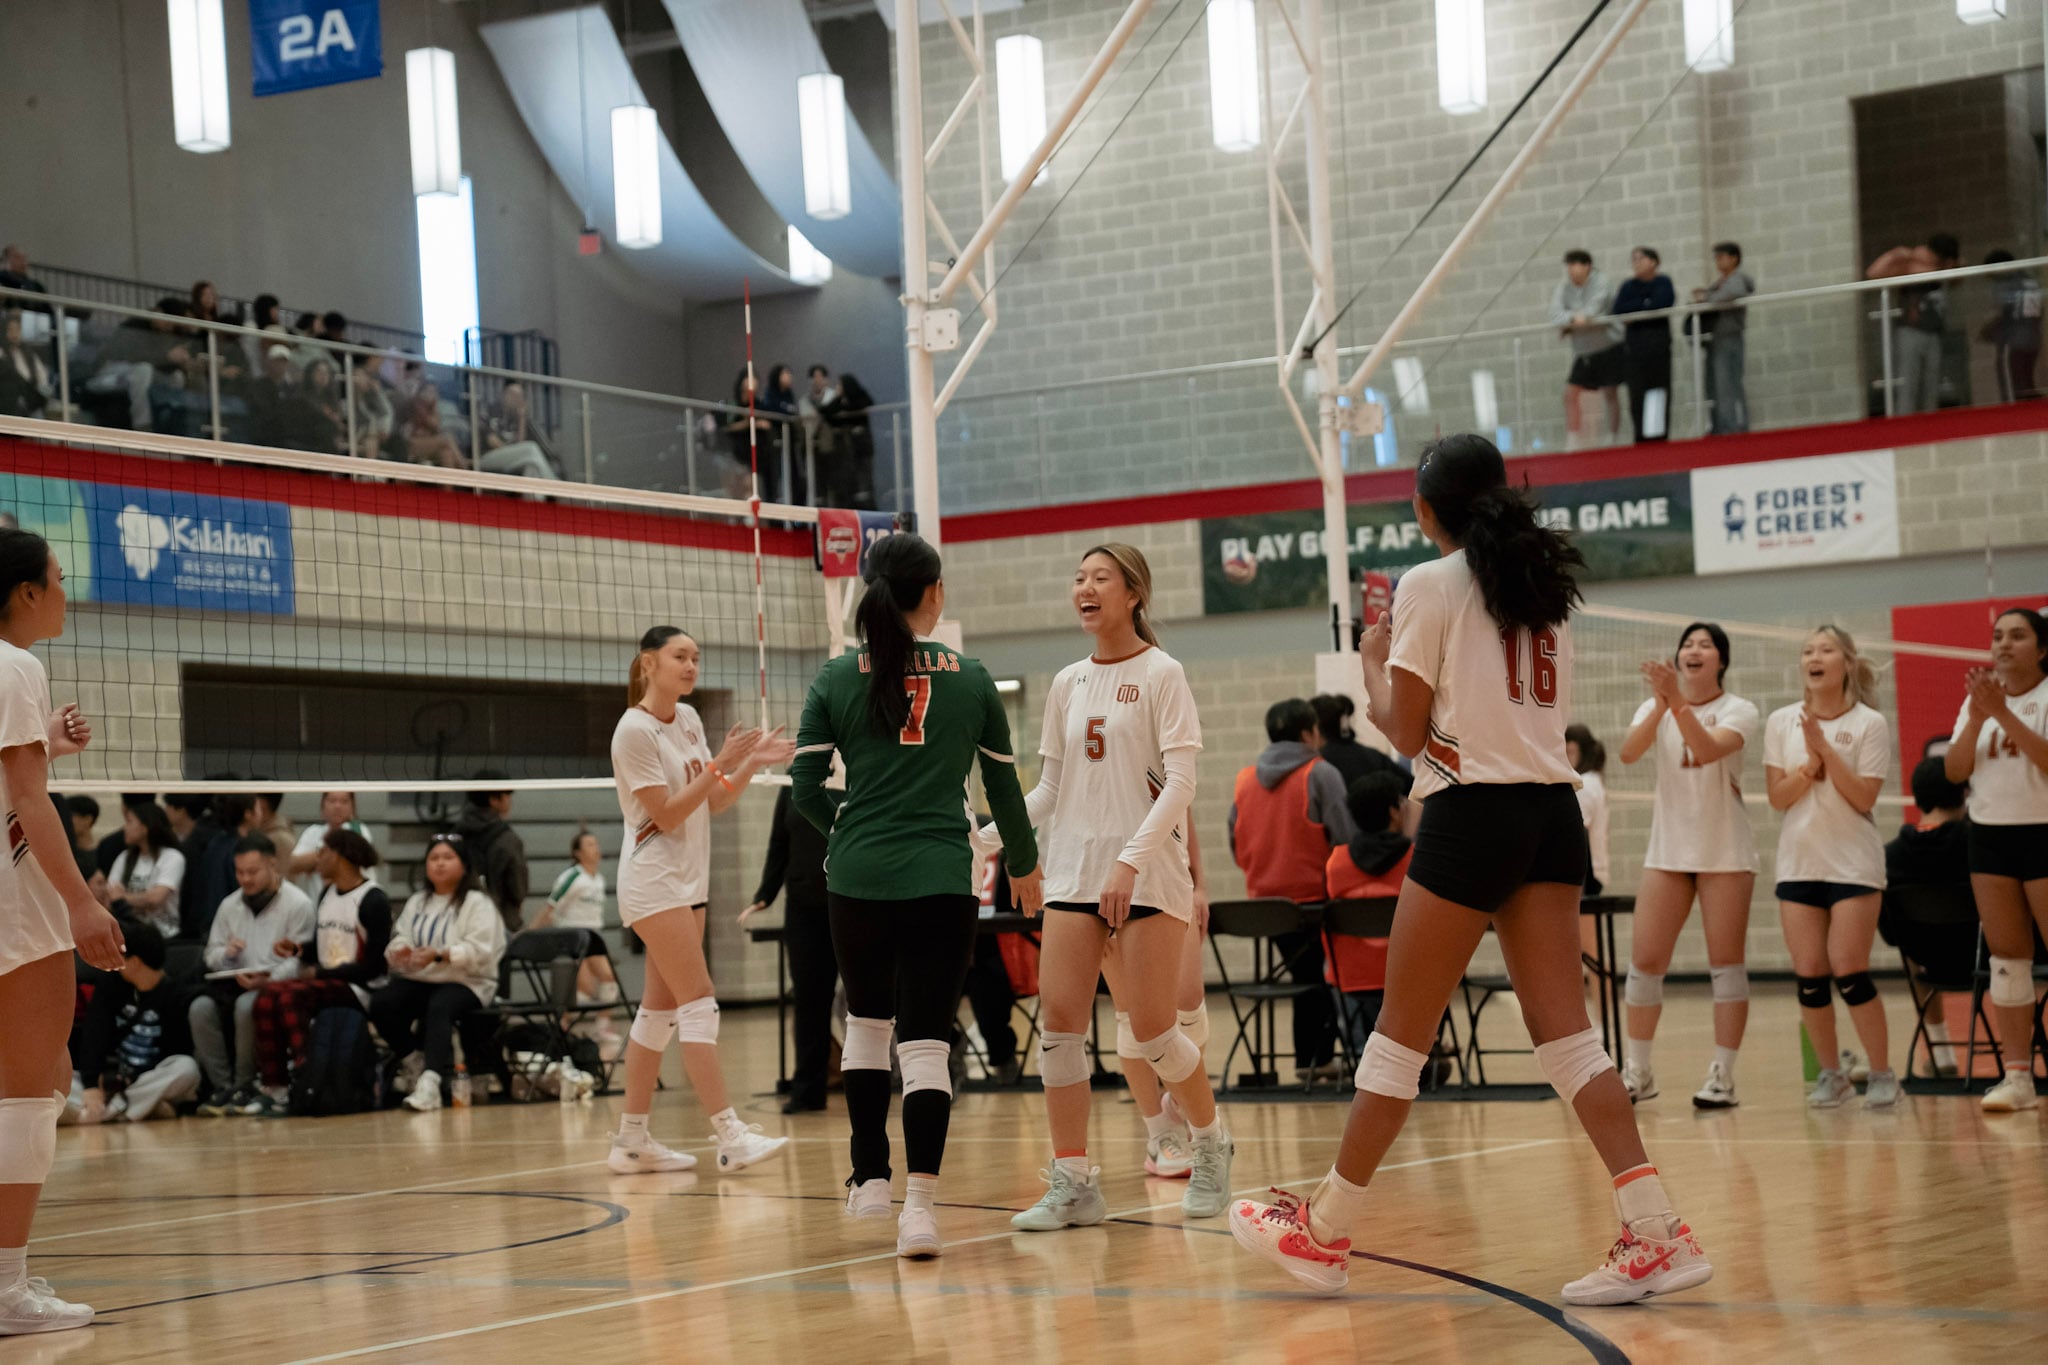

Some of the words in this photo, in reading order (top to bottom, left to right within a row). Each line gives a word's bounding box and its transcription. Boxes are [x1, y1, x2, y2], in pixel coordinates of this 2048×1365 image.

[279, 8, 357, 62] 2A
[1755, 480, 1865, 511] FOREST
[169, 514, 276, 560] Kalahari
[1299, 526, 1375, 559] GF
[1578, 496, 1671, 533] GAME
[1755, 509, 1848, 536] CREEK
[1500, 624, 1558, 709] 16
[899, 675, 932, 745] 7
[1116, 684, 1140, 704] UTD
[1084, 715, 1107, 763] 5
[1987, 727, 2020, 760] 14
